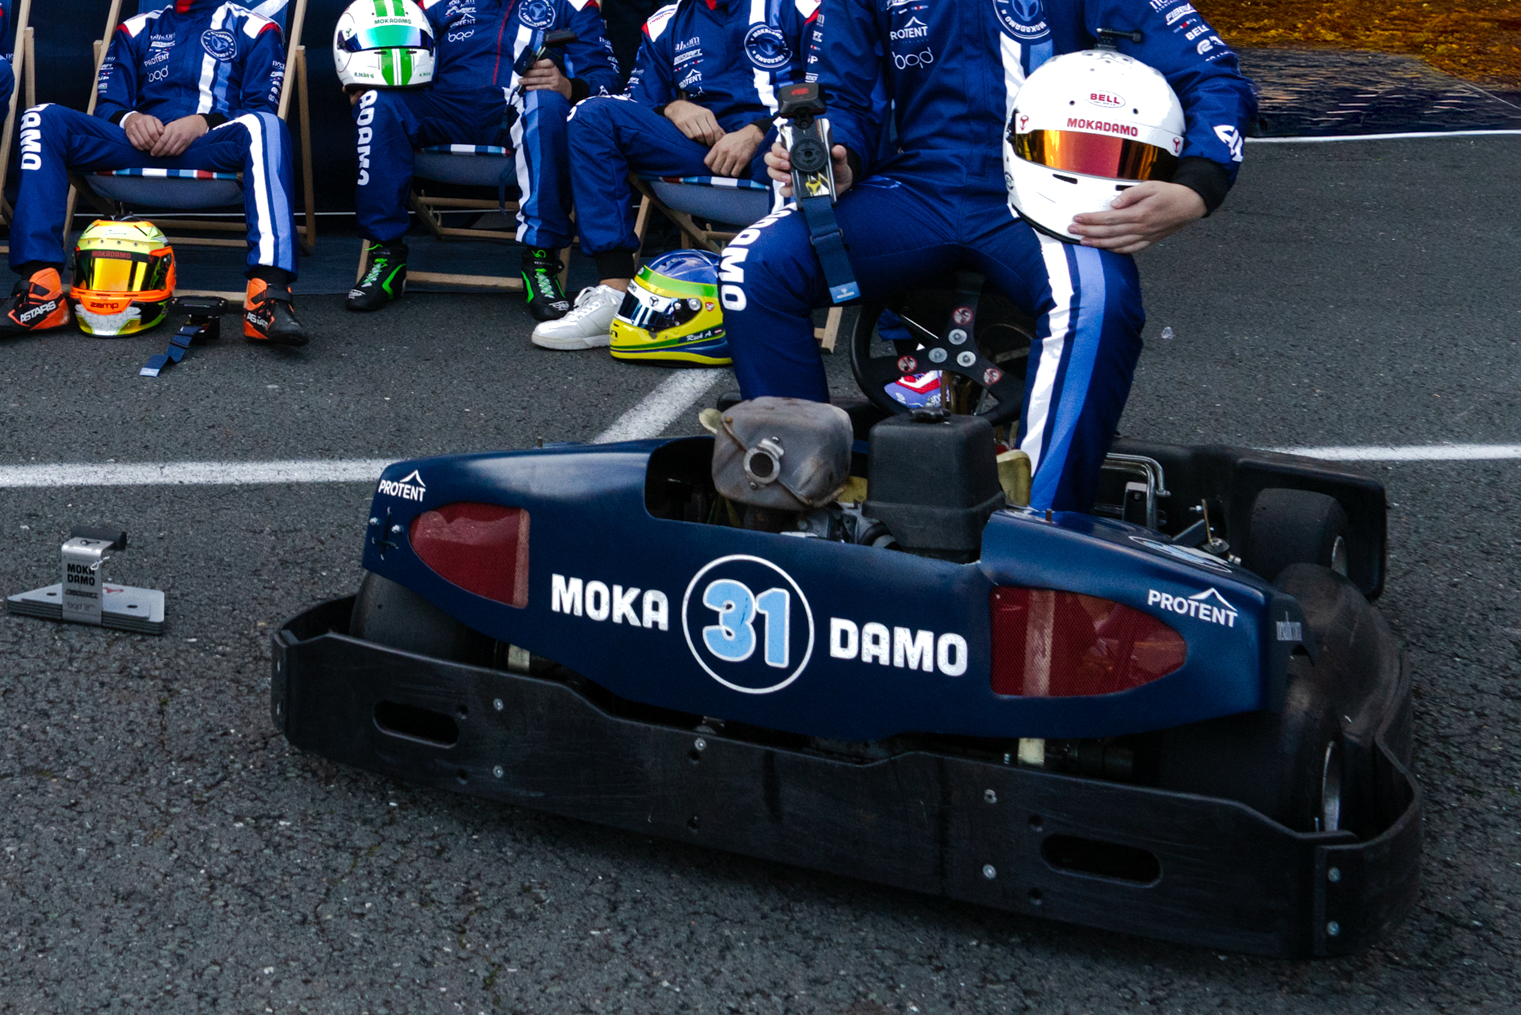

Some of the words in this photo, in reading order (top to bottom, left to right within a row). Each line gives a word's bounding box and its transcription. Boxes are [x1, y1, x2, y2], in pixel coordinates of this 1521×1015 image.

[1089, 92, 1121, 105] BELL
[1067, 117, 1138, 137] MOKADAMO
[91, 250, 131, 259] MOKADAMO
[378, 477, 425, 502] PROTENT
[67, 562, 96, 576] MOKA
[67, 573, 96, 586] DAMO
[1147, 588, 1238, 628] PROTENT
[551, 573, 669, 631] MOKA
[702, 578, 790, 669] 31
[829, 617, 968, 677] DAMO
